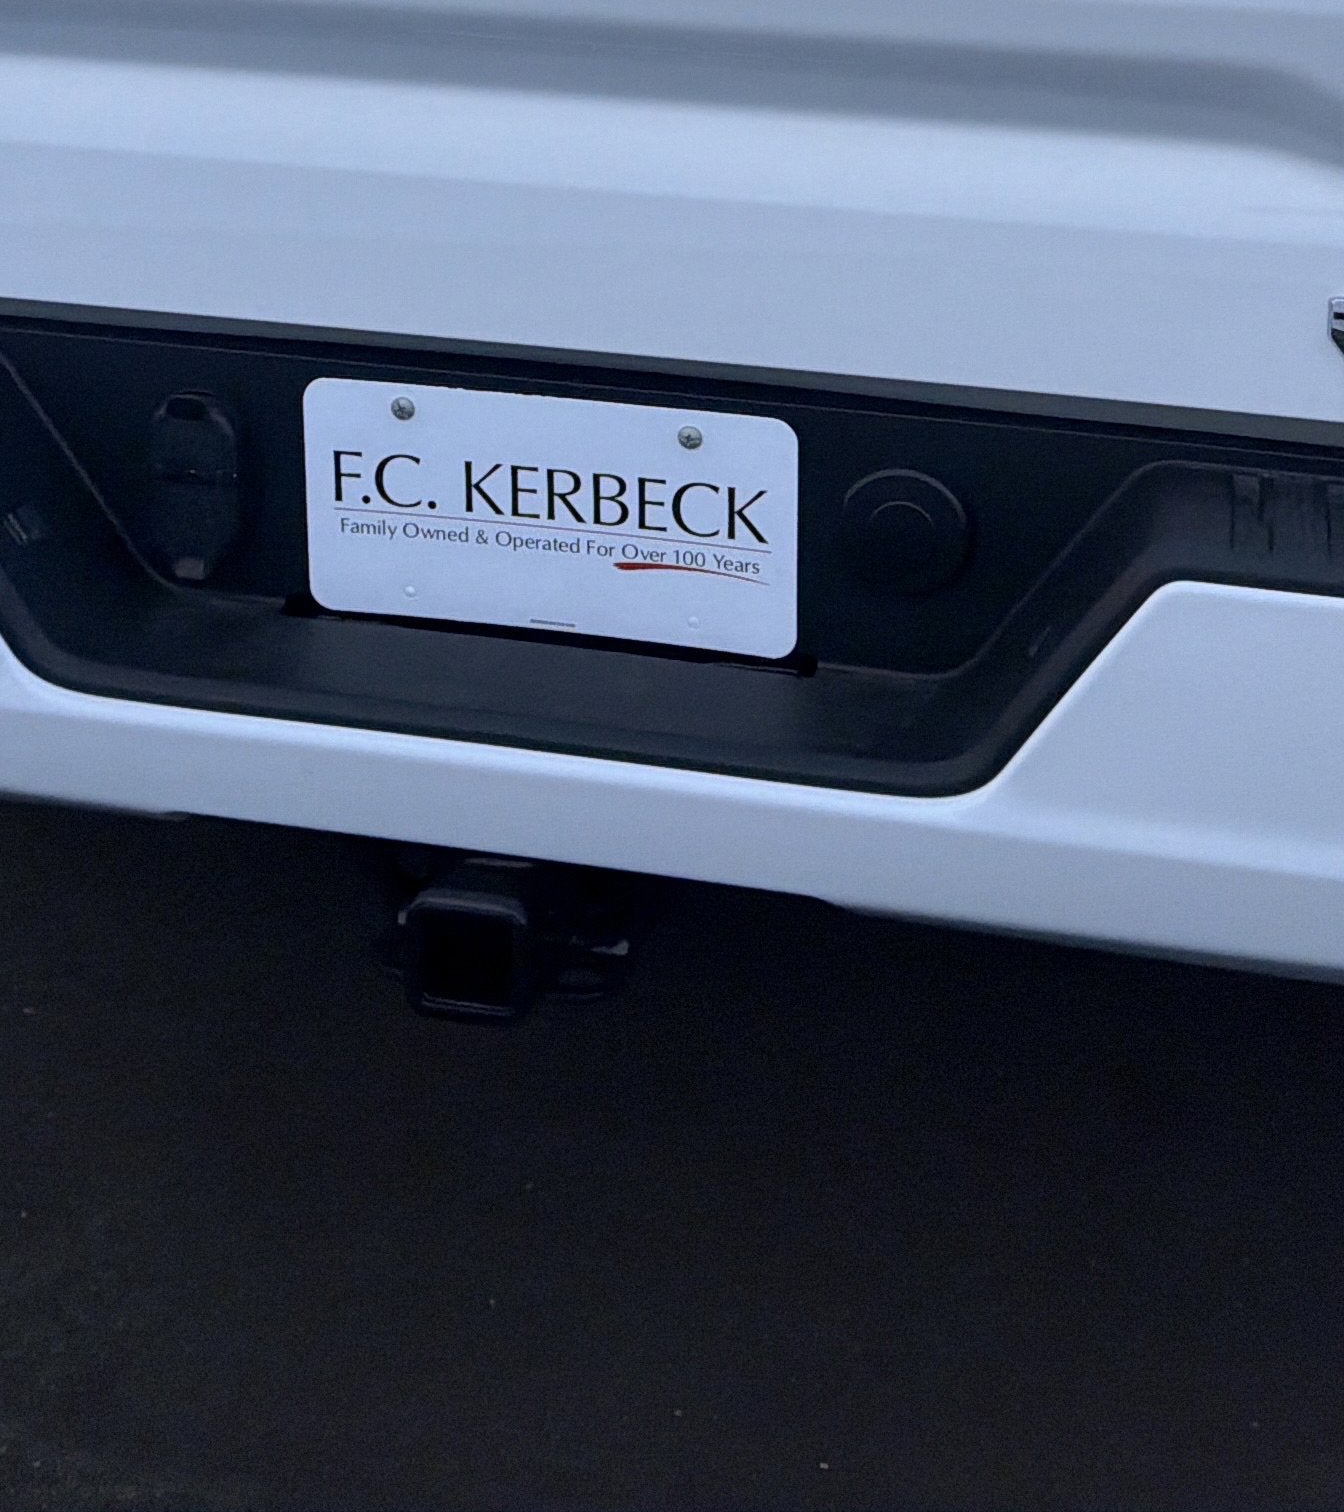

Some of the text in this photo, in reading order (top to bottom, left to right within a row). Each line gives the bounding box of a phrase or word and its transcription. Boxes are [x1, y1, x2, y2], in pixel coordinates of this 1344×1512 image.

[333, 450, 769, 544] F.C. KERBECK
[341, 518, 760, 575] Family Owned & Operated For Over 100 Years
